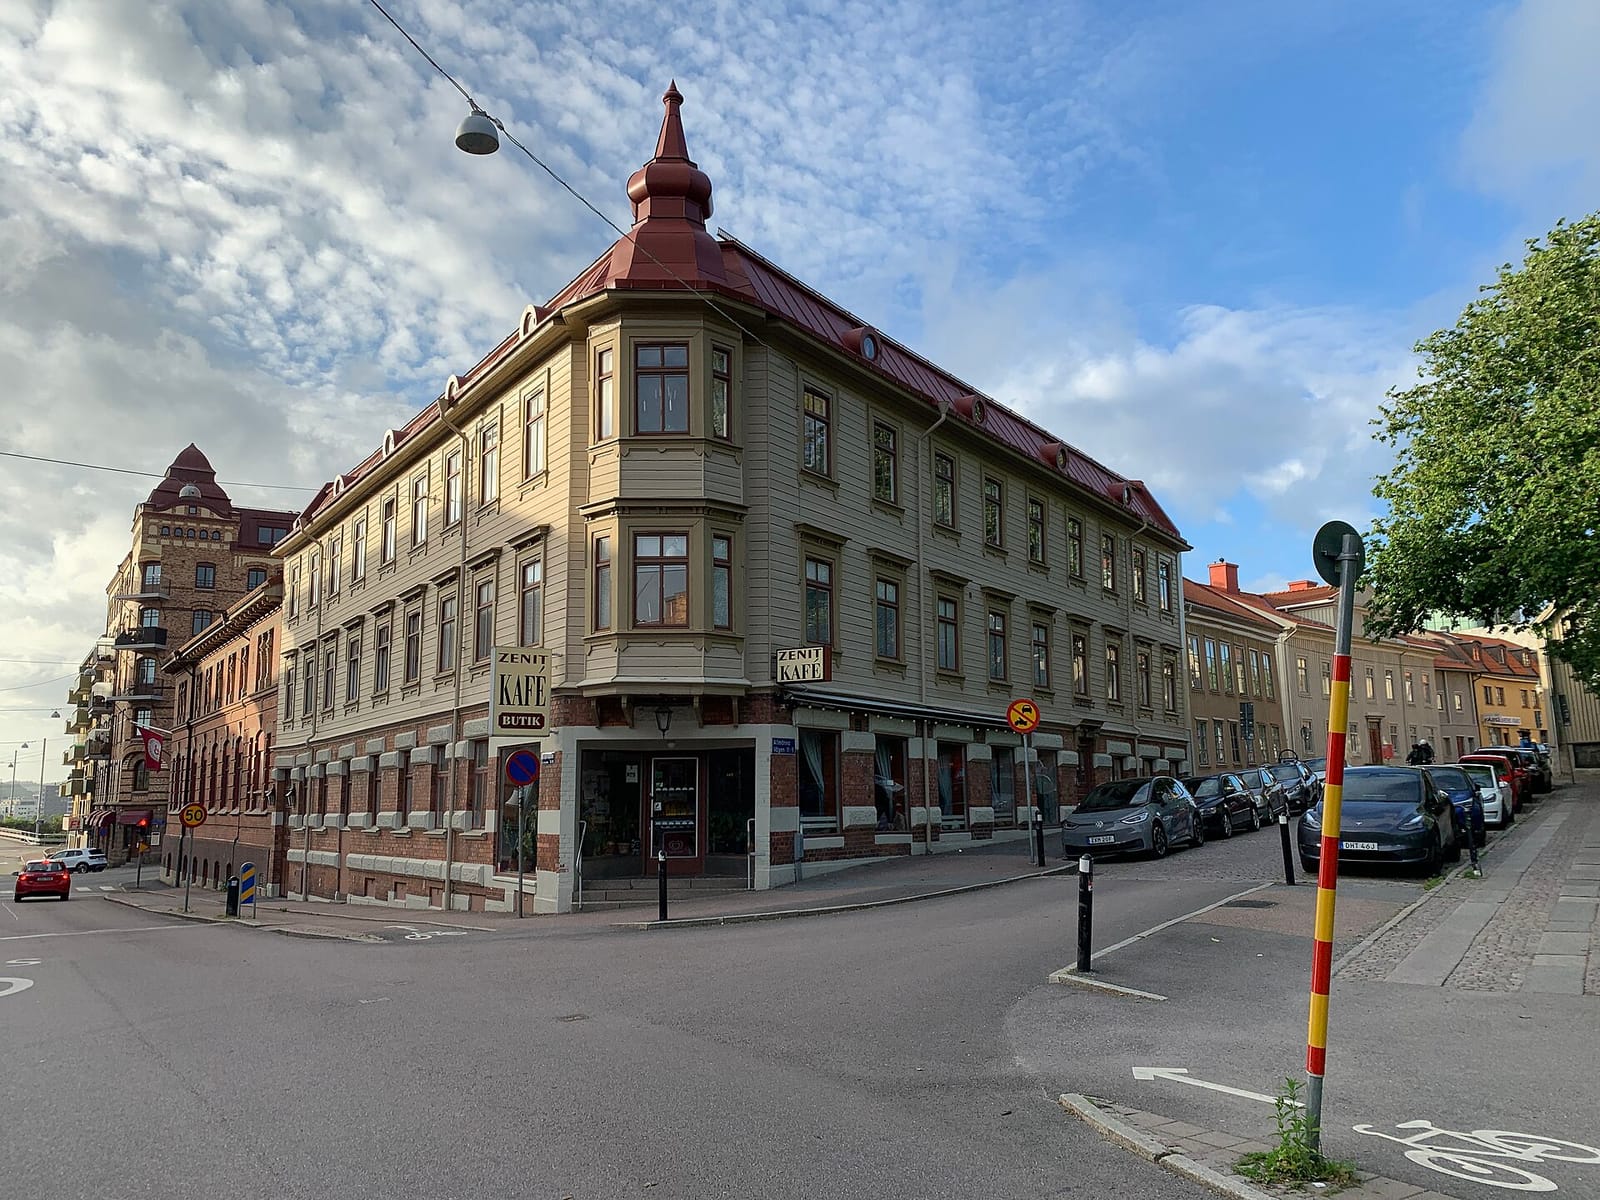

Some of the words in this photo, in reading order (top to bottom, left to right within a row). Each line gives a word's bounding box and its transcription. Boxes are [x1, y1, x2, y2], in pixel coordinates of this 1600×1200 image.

[498, 652, 548, 664] ZENIT
[778, 648, 822, 661] ZENIT
[780, 658, 821, 681] KAFÉ
[498, 665, 547, 707] KAFÉ
[502, 715, 541, 726] BUTIK
[185, 809, 203, 822] 50
